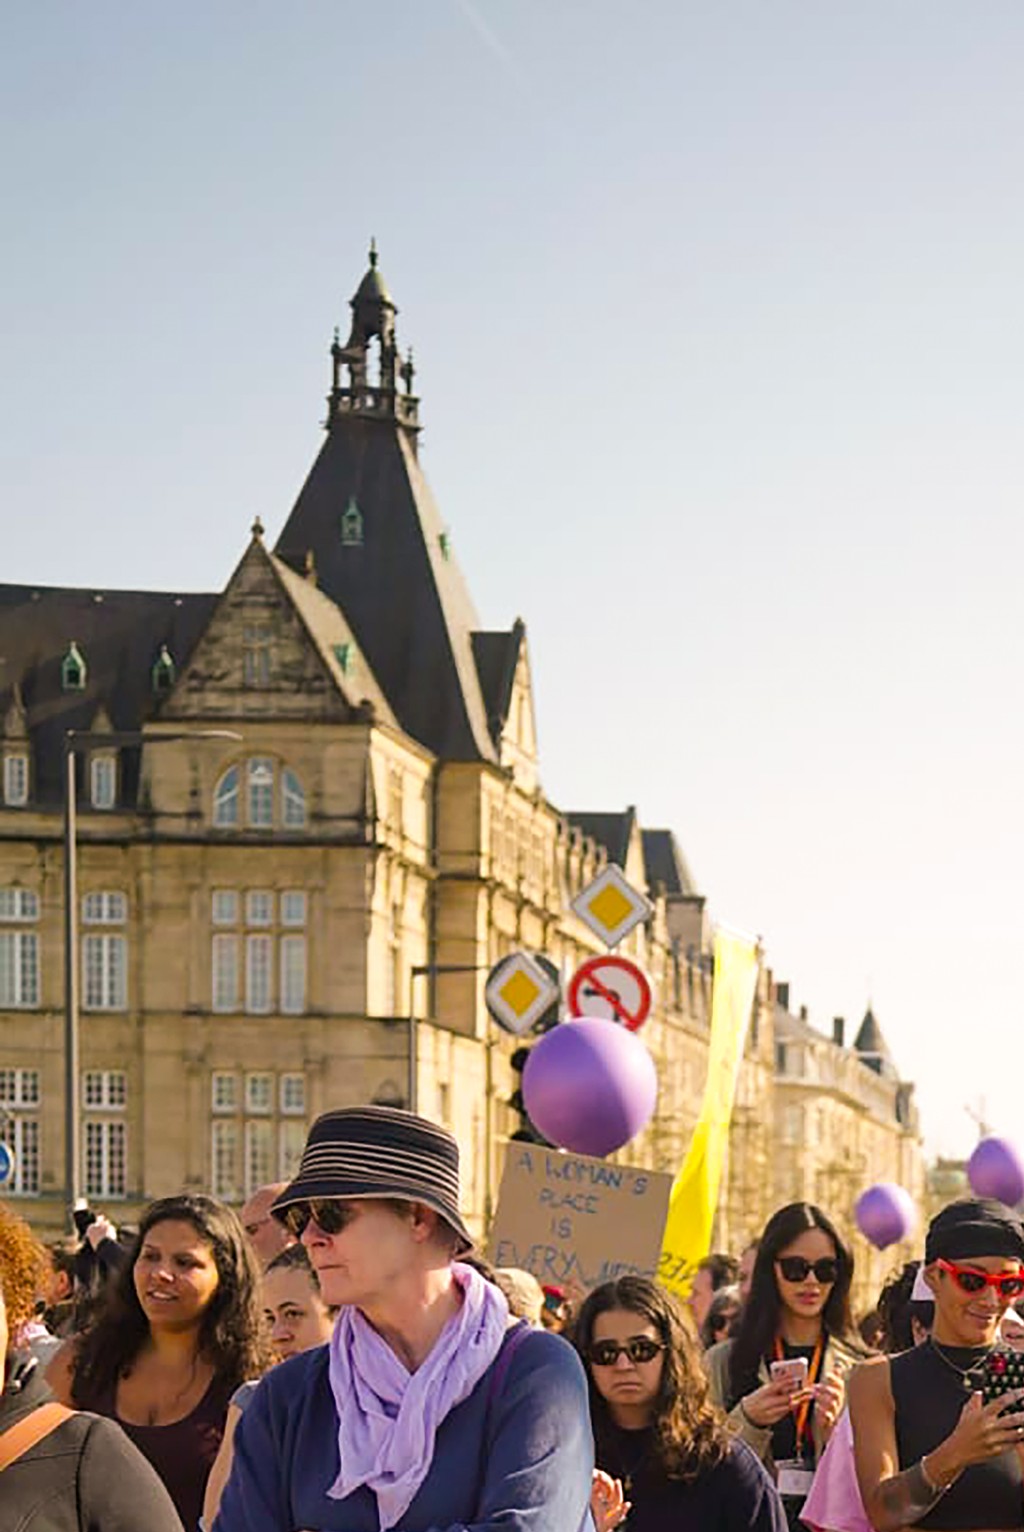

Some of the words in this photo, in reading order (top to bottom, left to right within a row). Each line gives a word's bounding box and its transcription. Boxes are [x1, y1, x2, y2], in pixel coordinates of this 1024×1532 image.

[517, 1151, 533, 1174] A
[538, 1187, 599, 1215] PLACE
[551, 1217, 572, 1239] IS
